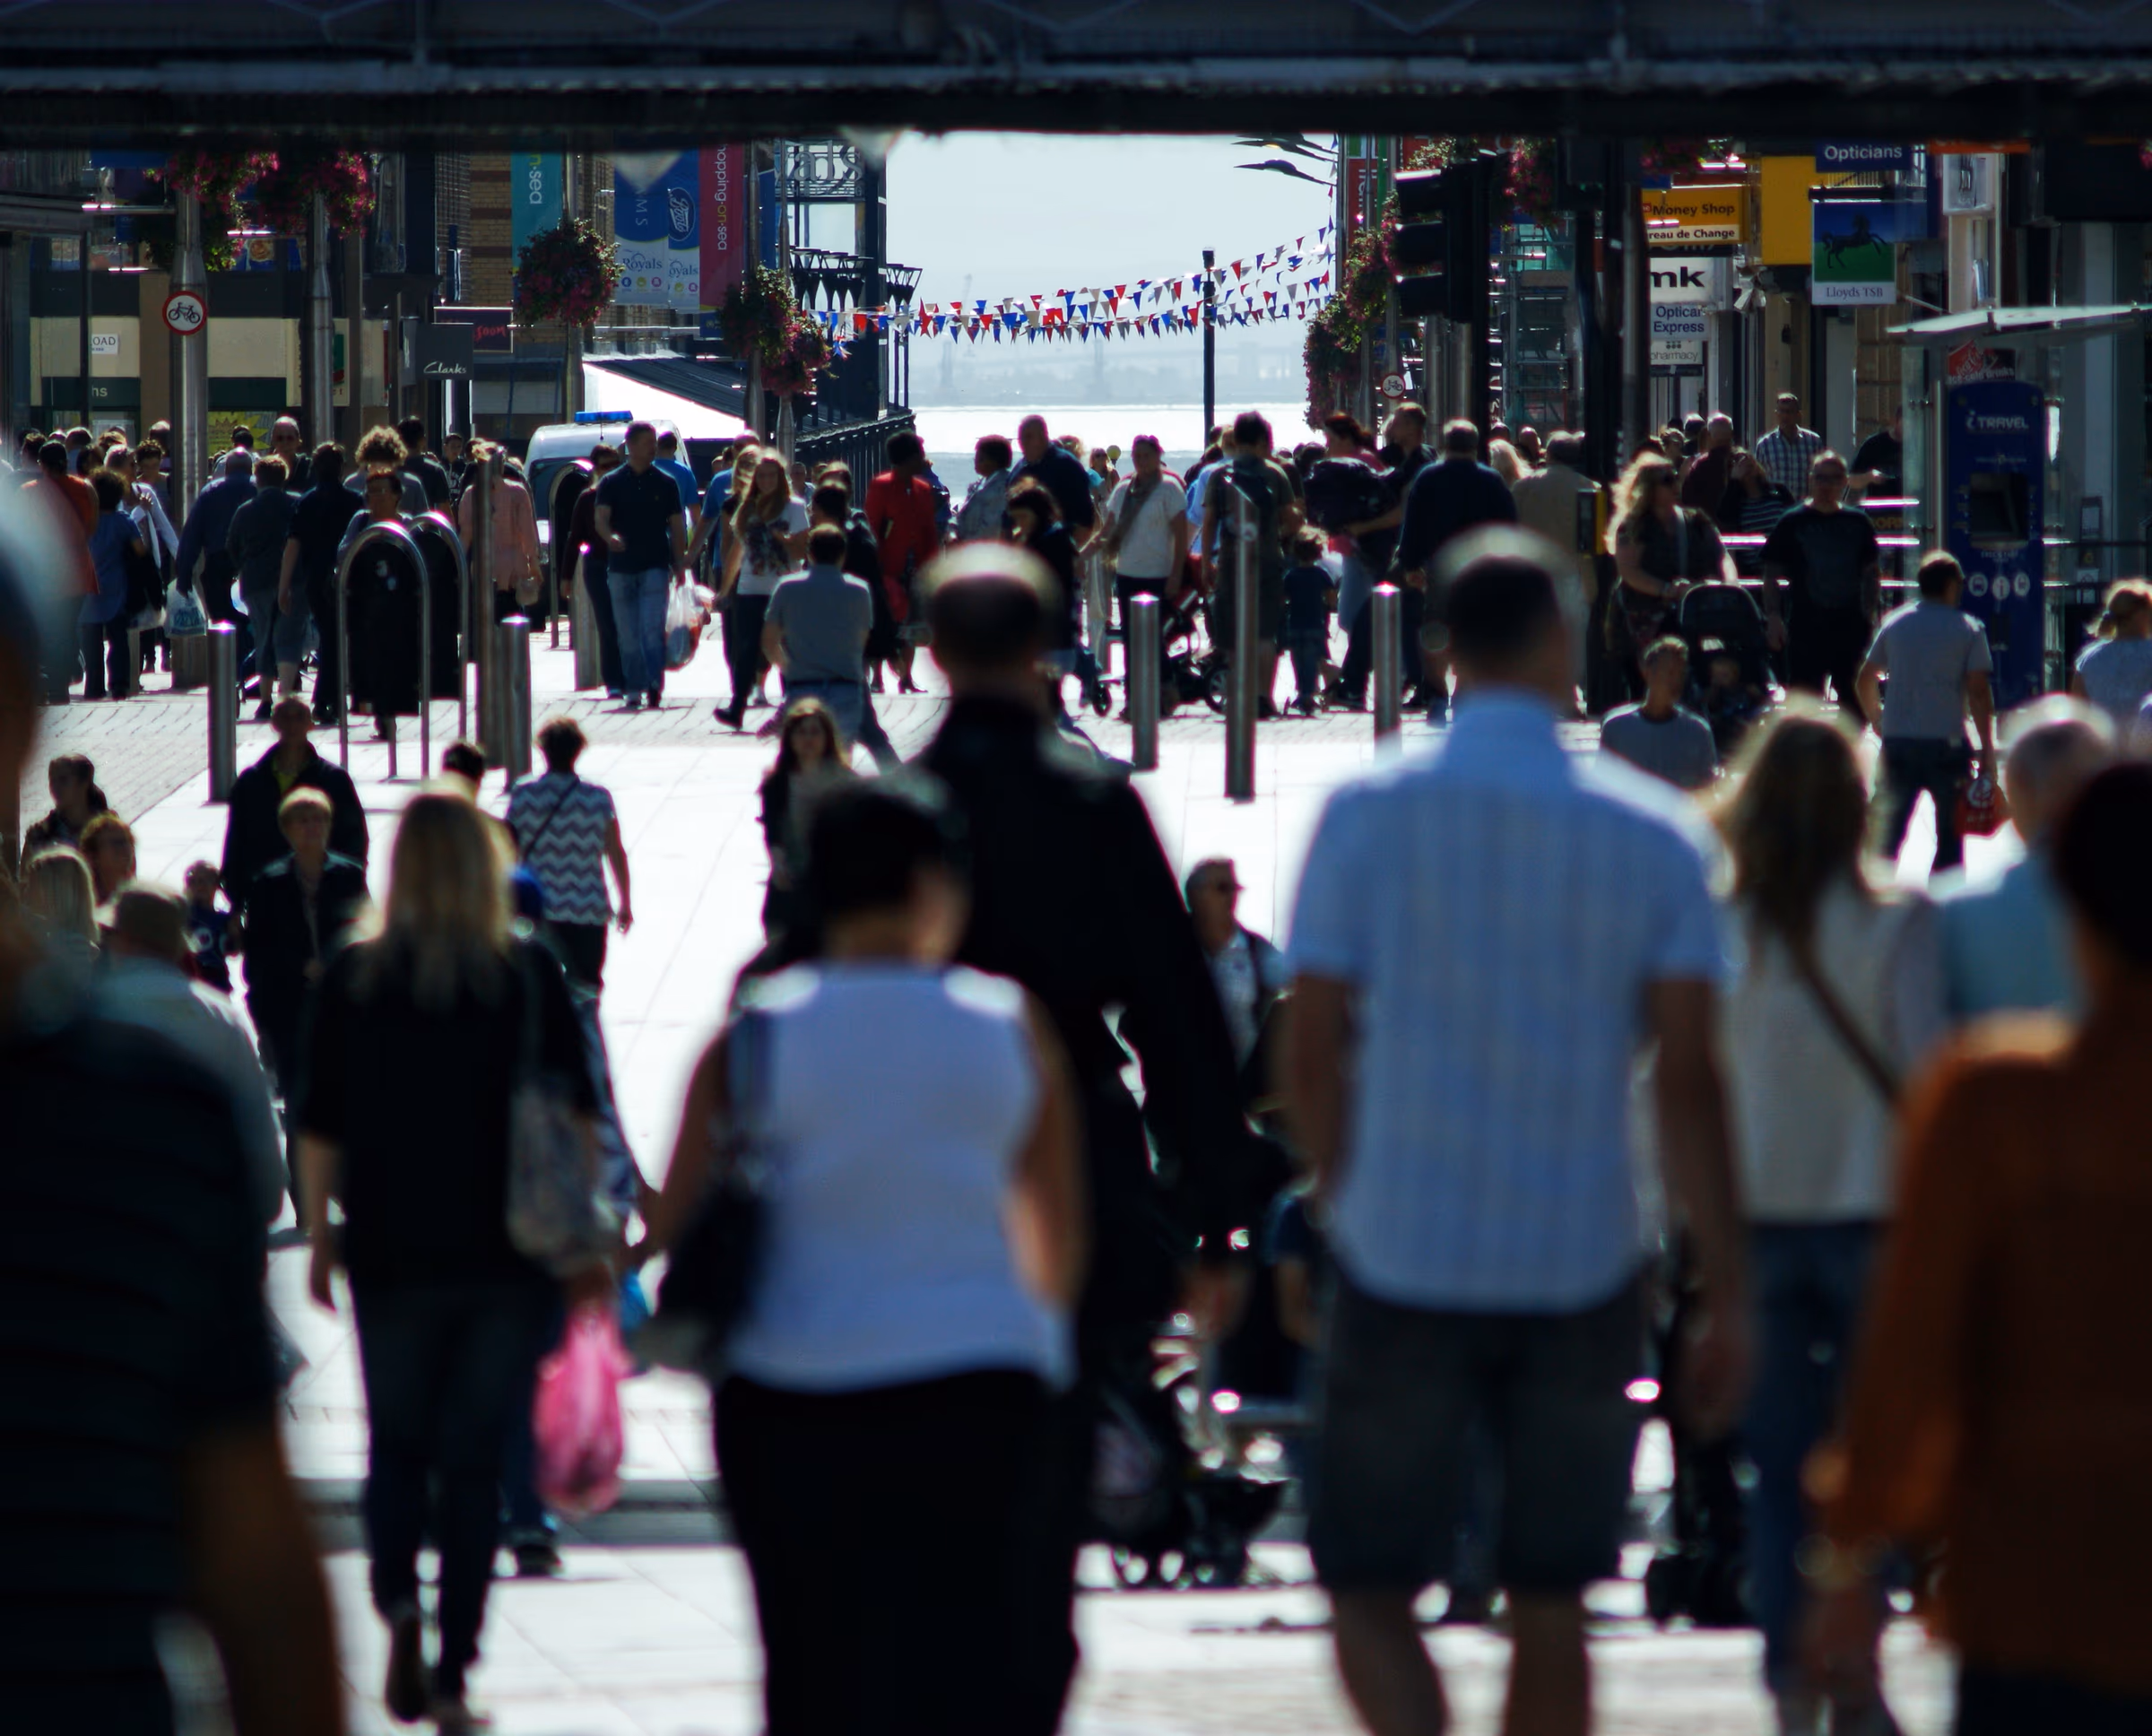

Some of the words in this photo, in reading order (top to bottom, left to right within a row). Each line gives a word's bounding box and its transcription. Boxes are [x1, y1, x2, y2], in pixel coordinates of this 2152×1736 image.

[1824, 144, 1903, 162] Opticians
[1653, 205, 1697, 217] Money
[1701, 204, 1736, 215] Shop
[1677, 230, 1690, 239] de
[1694, 229, 1735, 239] Change
[622, 256, 663, 272] Royals
[1826, 287, 1860, 299] Lloyds
[1862, 287, 1883, 297] TSB
[1653, 321, 1705, 335] Express
[423, 361, 466, 374] Clarks
[1977, 416, 2029, 430] TRAVEL
